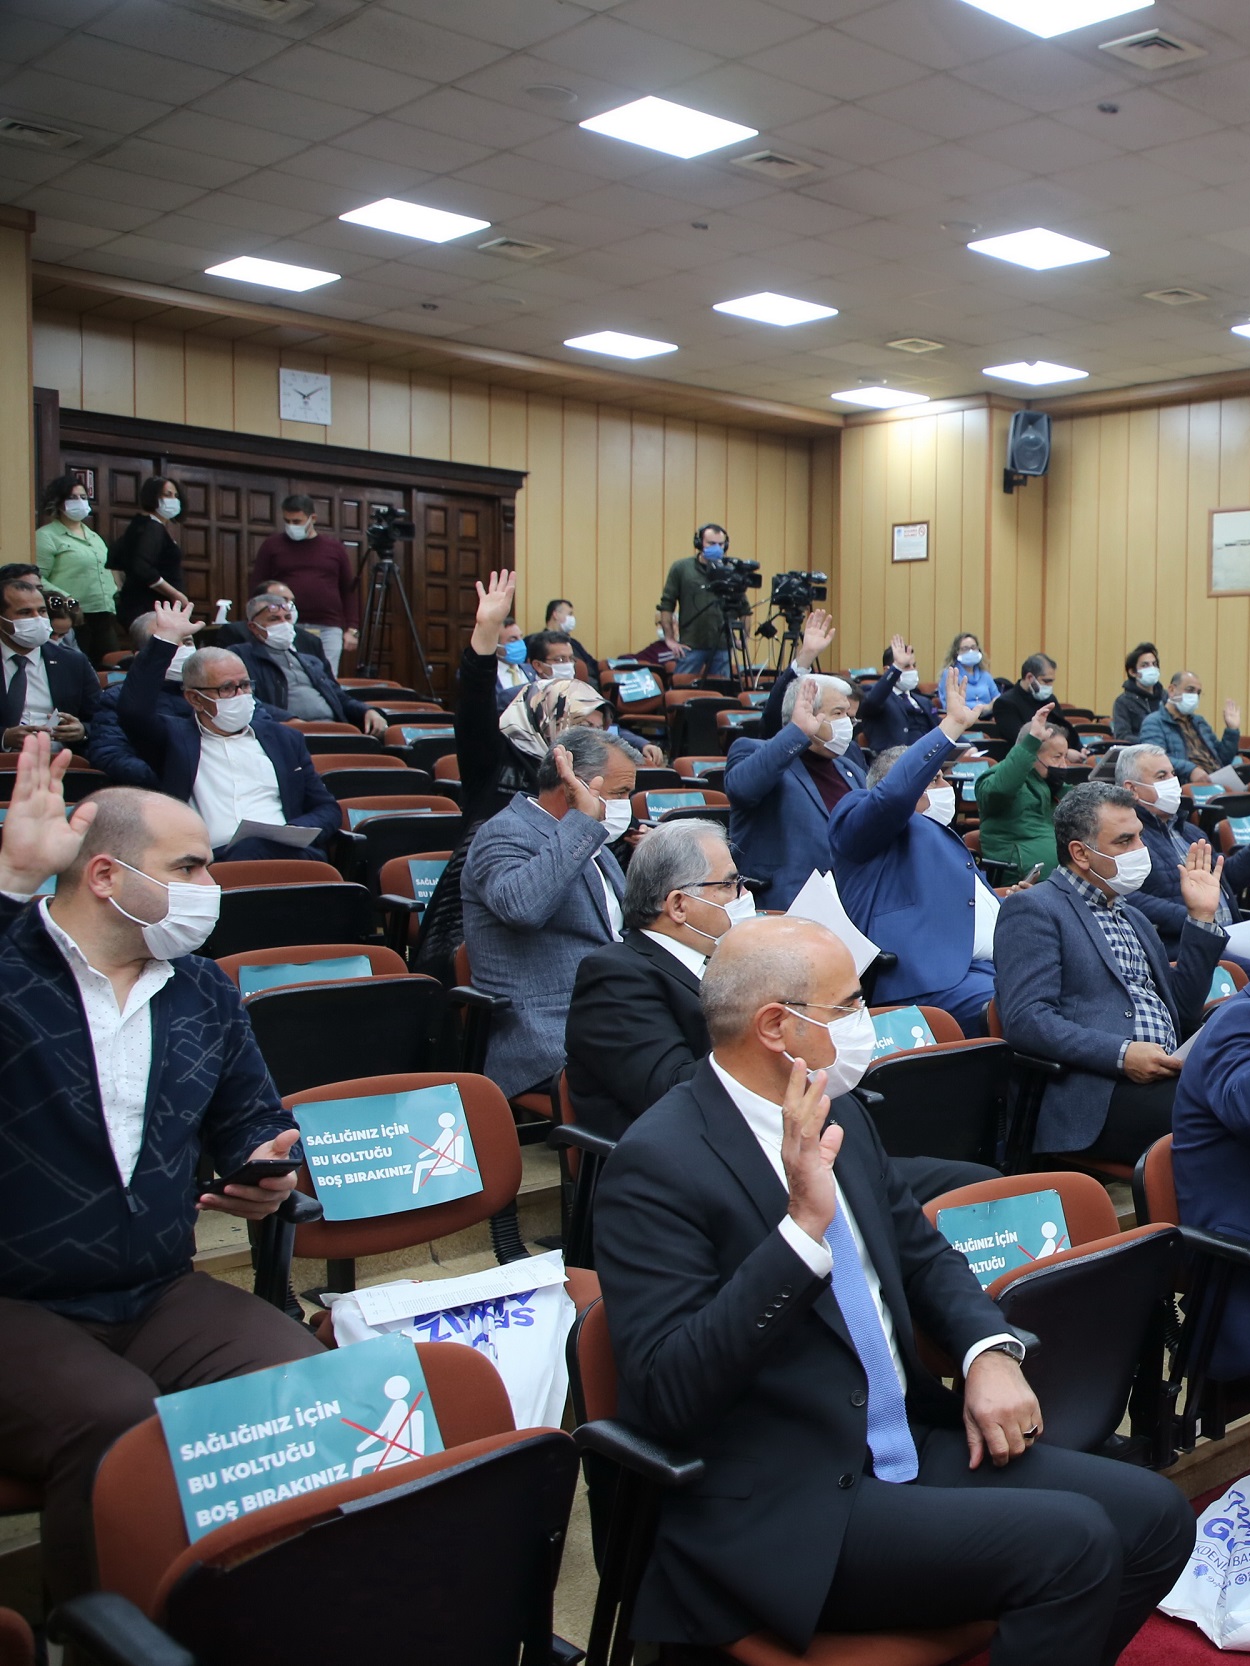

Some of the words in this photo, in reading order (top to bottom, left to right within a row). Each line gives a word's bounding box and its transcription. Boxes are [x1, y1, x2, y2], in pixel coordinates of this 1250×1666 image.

[306, 1126, 379, 1147] SAĞLIĞINIZ
[381, 1122, 410, 1140] İÇİN
[312, 1155, 329, 1167] BU
[332, 1146, 393, 1165] KOLTUĞU
[317, 1174, 343, 1188] BOŞ
[344, 1164, 414, 1184] BIRAKINIZ
[951, 1236, 995, 1255] ĞLIĞINIZ
[995, 1230, 1019, 1248] İÇİN
[968, 1256, 1006, 1274] OLTUĞU
[180, 1414, 294, 1462] SAĞLIĞINIZ
[295, 1400, 342, 1427] İÇİN
[188, 1475, 217, 1495] BU
[220, 1441, 317, 1485] KOLTUĞU
[195, 1500, 240, 1528] BOŞ
[241, 1462, 350, 1512] BIRAKINIZ
